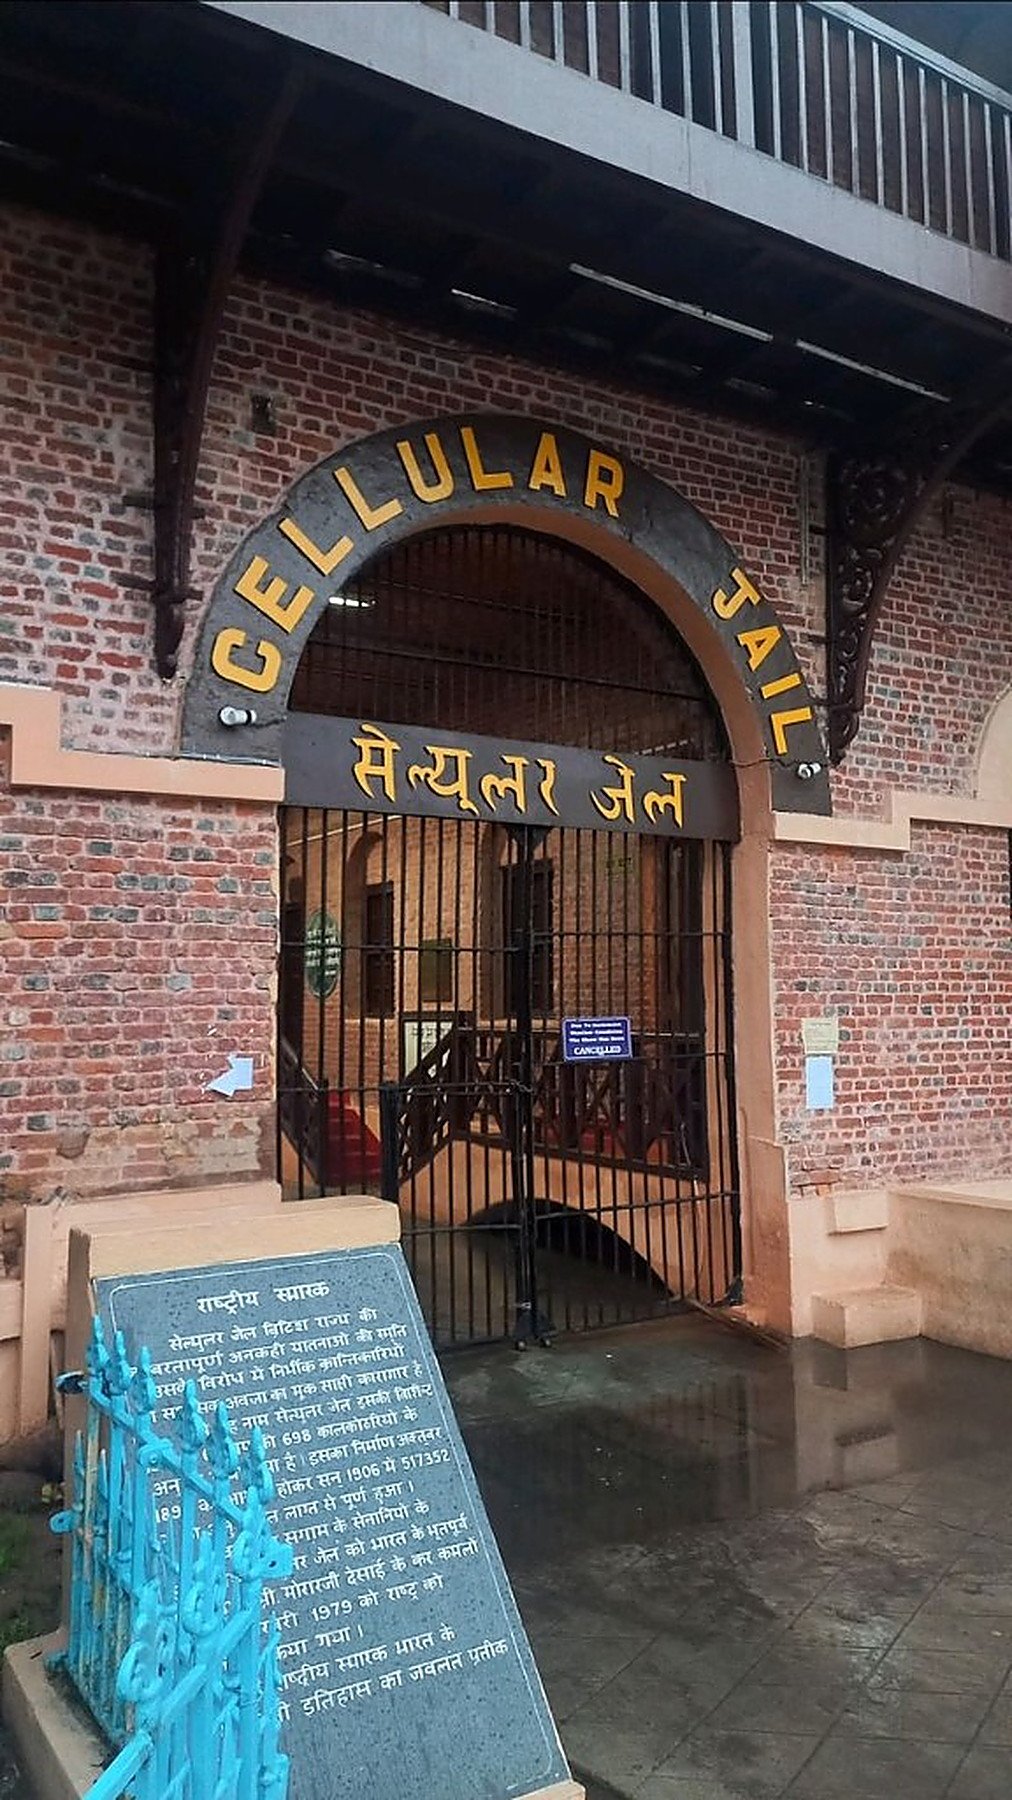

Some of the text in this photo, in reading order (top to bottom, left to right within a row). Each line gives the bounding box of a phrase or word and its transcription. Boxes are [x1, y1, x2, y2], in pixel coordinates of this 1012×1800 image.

[211, 426, 812, 757] CELLULAR JAIL
[589, 755, 687, 829] जेल
[196, 1281, 330, 1315] राष्ट्रीय स्मारक
[230, 1324, 257, 1341] जेल
[282, 1427, 312, 1446] 698
[346, 1463, 381, 1483] 1906
[401, 1448, 451, 1471] 517352
[370, 1530, 408, 1552] भारत
[344, 1557, 386, 1586] देसाई
[311, 1599, 354, 1622] 1979
[357, 1588, 380, 1608] को
[334, 1644, 389, 1673] स्मारक
[394, 1631, 435, 1656] भारत
[378, 1669, 403, 1691] का
